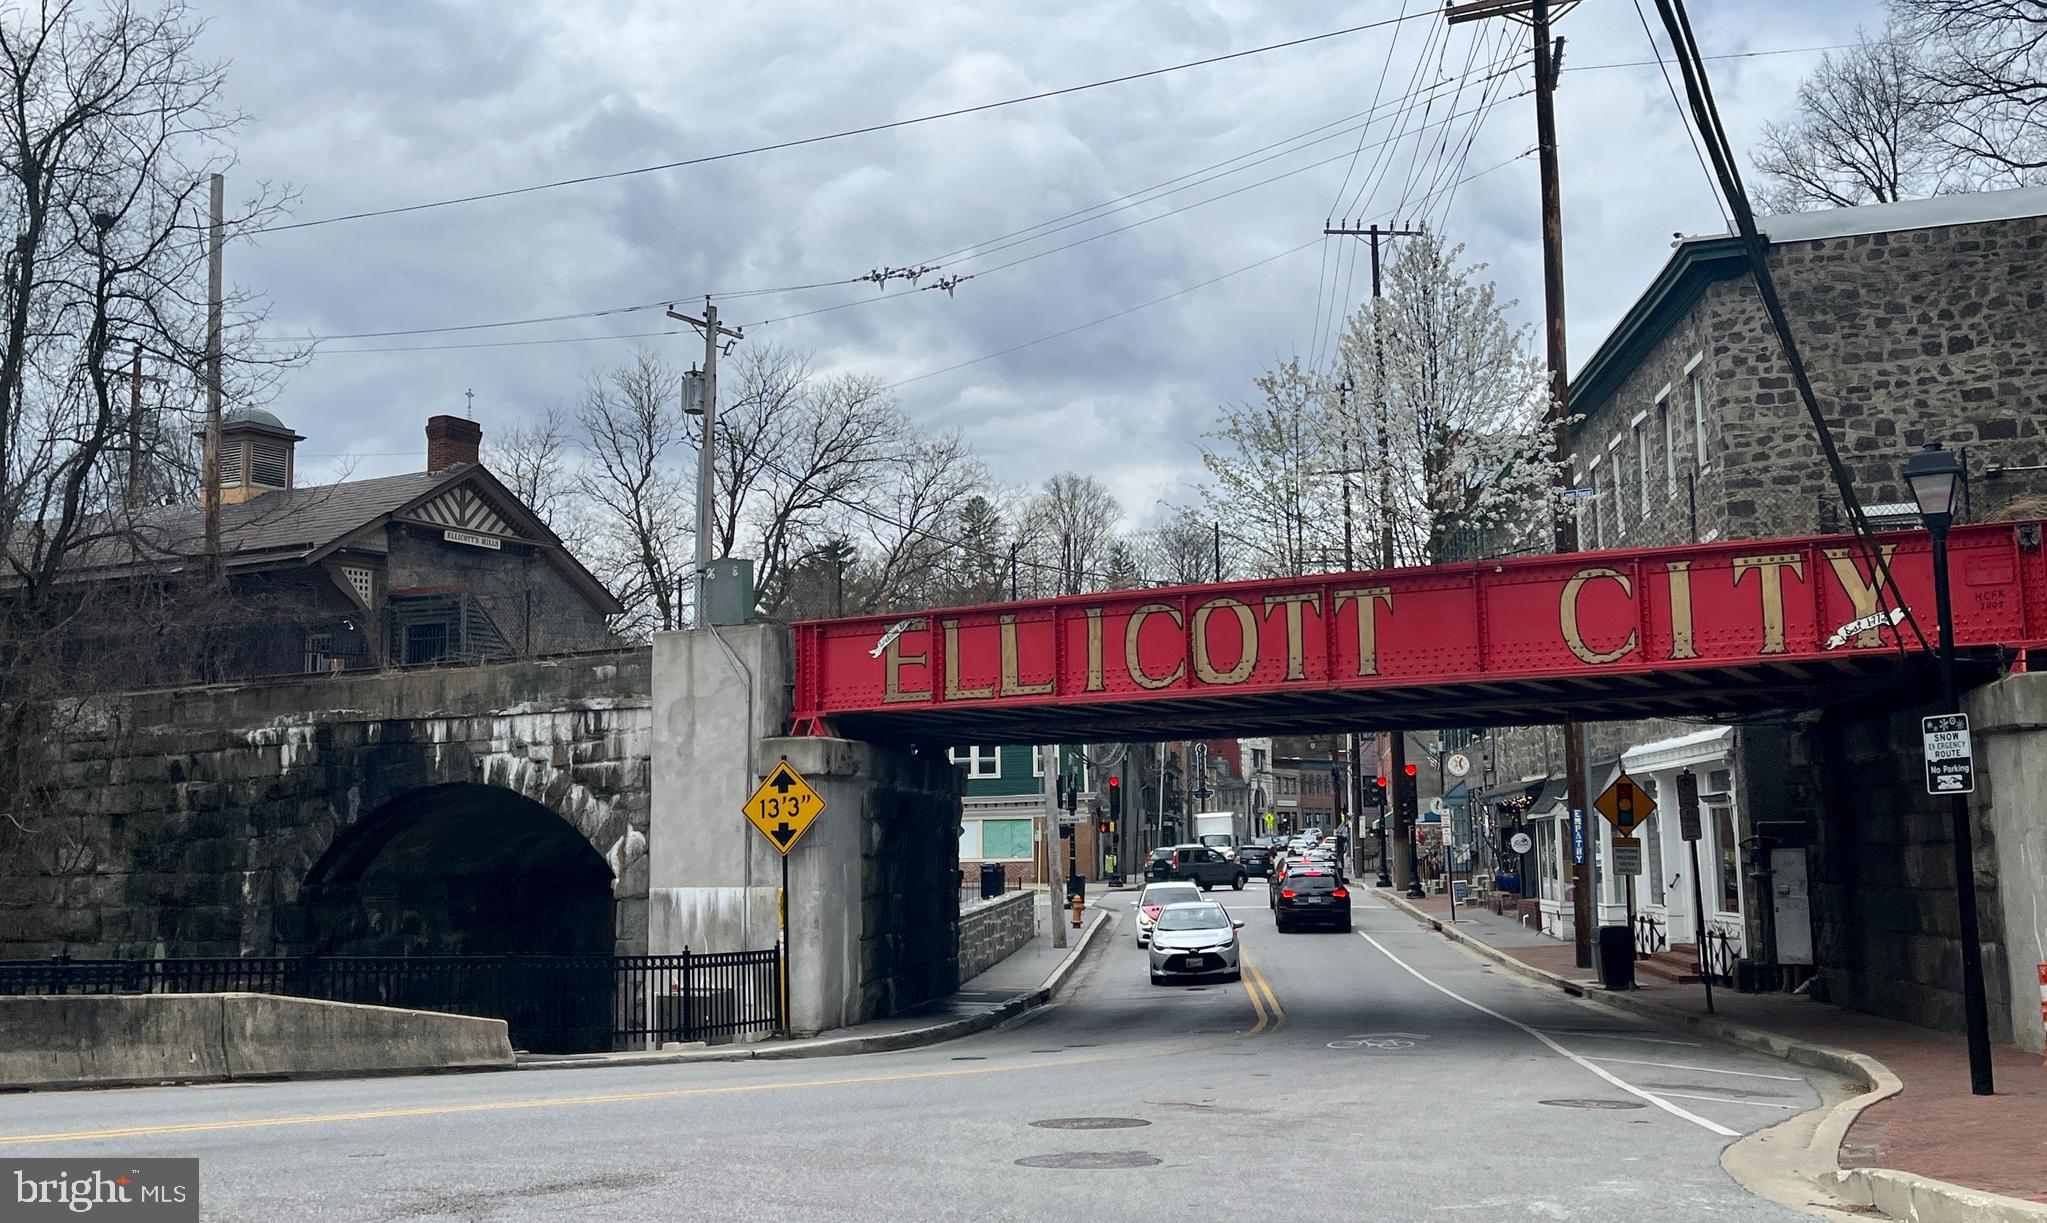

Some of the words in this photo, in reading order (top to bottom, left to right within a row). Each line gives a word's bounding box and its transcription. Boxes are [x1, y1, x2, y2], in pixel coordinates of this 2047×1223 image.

[882, 586, 1394, 704] ELLICOTT
[1559, 544, 1898, 665] CITY
[1934, 732, 1960, 742] SNOW
[1935, 749, 1961, 759] ROUTE
[1930, 766, 1941, 774] No
[1943, 764, 1970, 774] Parking
[1574, 809, 1583, 864] EMPATHY
